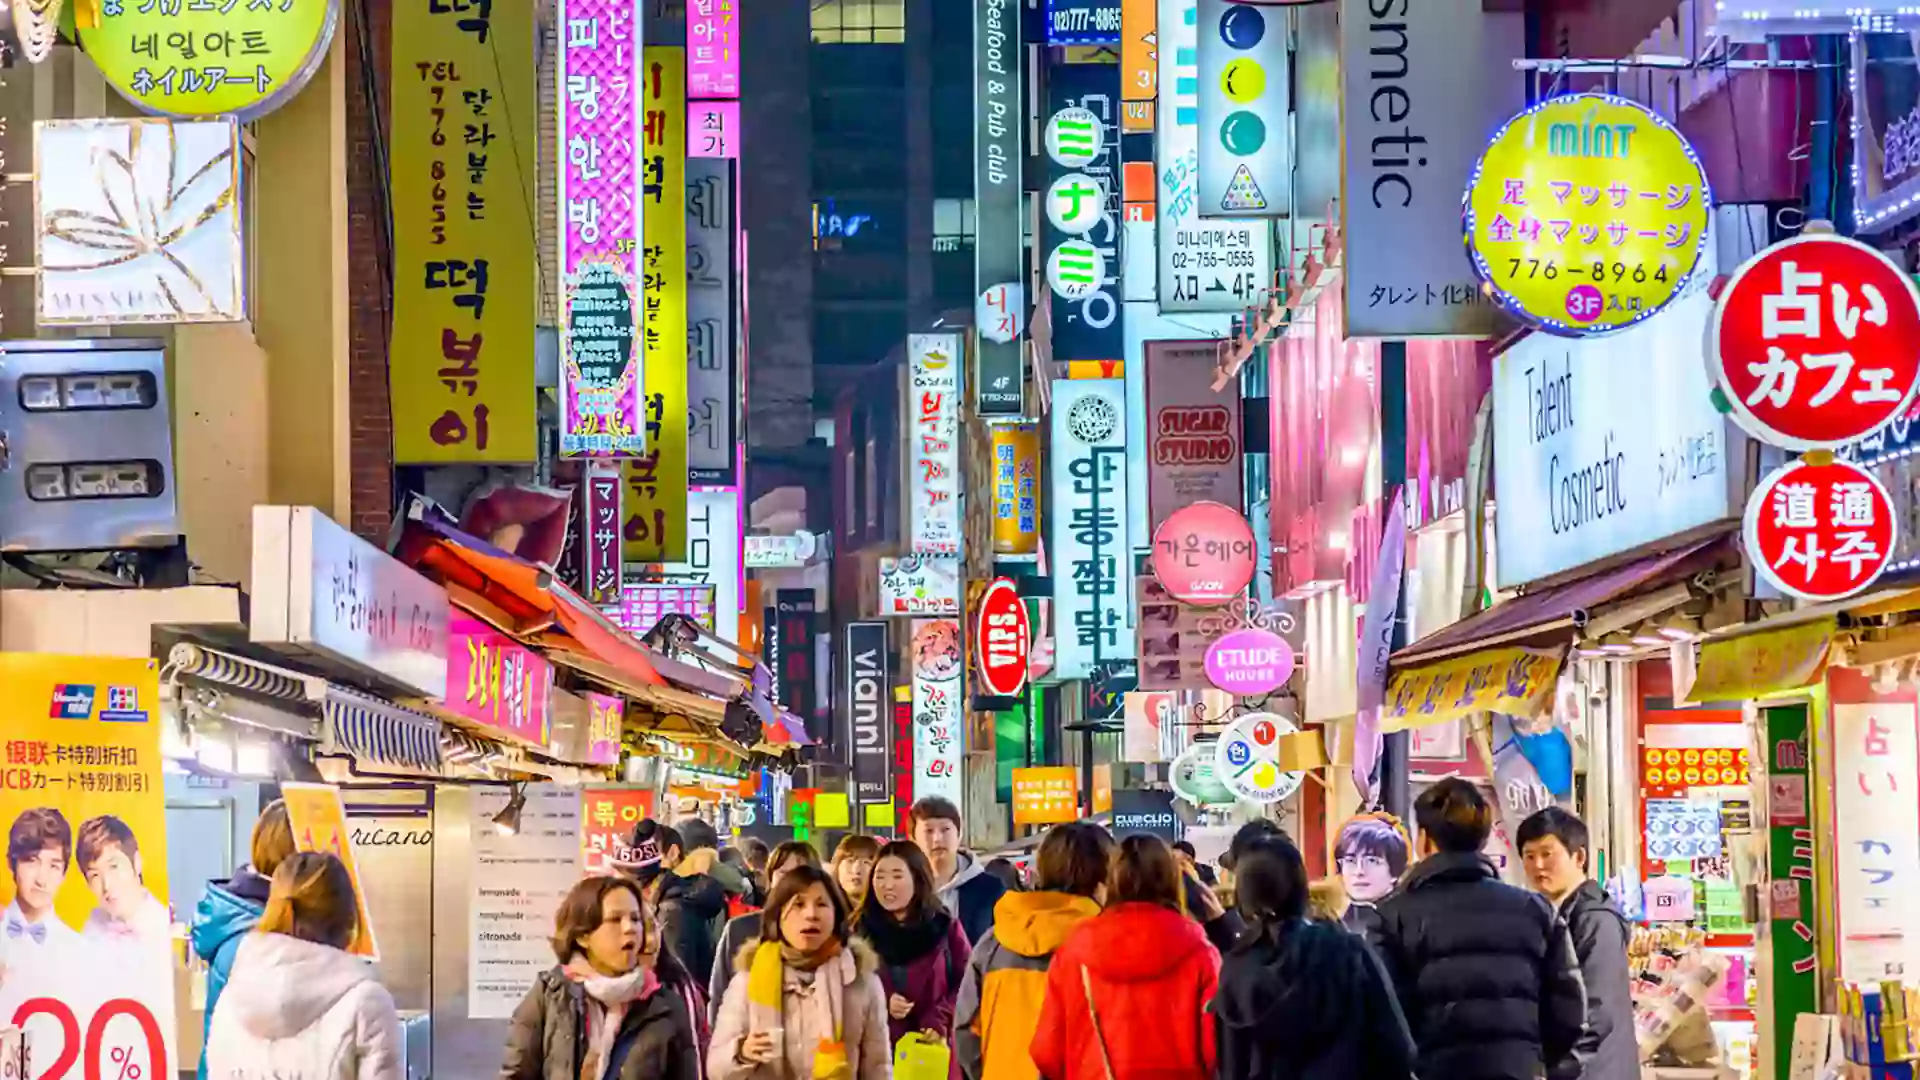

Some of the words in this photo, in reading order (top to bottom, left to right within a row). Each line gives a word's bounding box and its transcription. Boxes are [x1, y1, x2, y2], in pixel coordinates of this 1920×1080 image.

[131, 30, 271, 60] 네일아트
[132, 65, 272, 95] ネイルアート
[988, 100, 1008, 138] Pub
[988, 144, 1009, 185] club
[1550, 180, 1694, 211] マッサージ
[1232, 273, 1256, 300] 4F
[1509, 258, 1669, 285] 776-8964
[1569, 292, 1602, 316] 3F
[1761, 261, 1888, 340] 占い
[425, 258, 490, 451] 떡볶이
[1746, 347, 1902, 409] カフェ
[1525, 350, 1575, 446] Talent
[1162, 411, 1226, 434] SUGAR
[1157, 438, 1231, 463] STUDIO
[1549, 430, 1628, 535] Cosmetic
[1774, 482, 1876, 529] 道通
[594, 483, 616, 590] マッサージ
[1158, 533, 1253, 567] 가온헤어
[1773, 532, 1881, 583] 사주
[1217, 648, 1283, 666] ETUDE
[854, 648, 884, 754] viani
